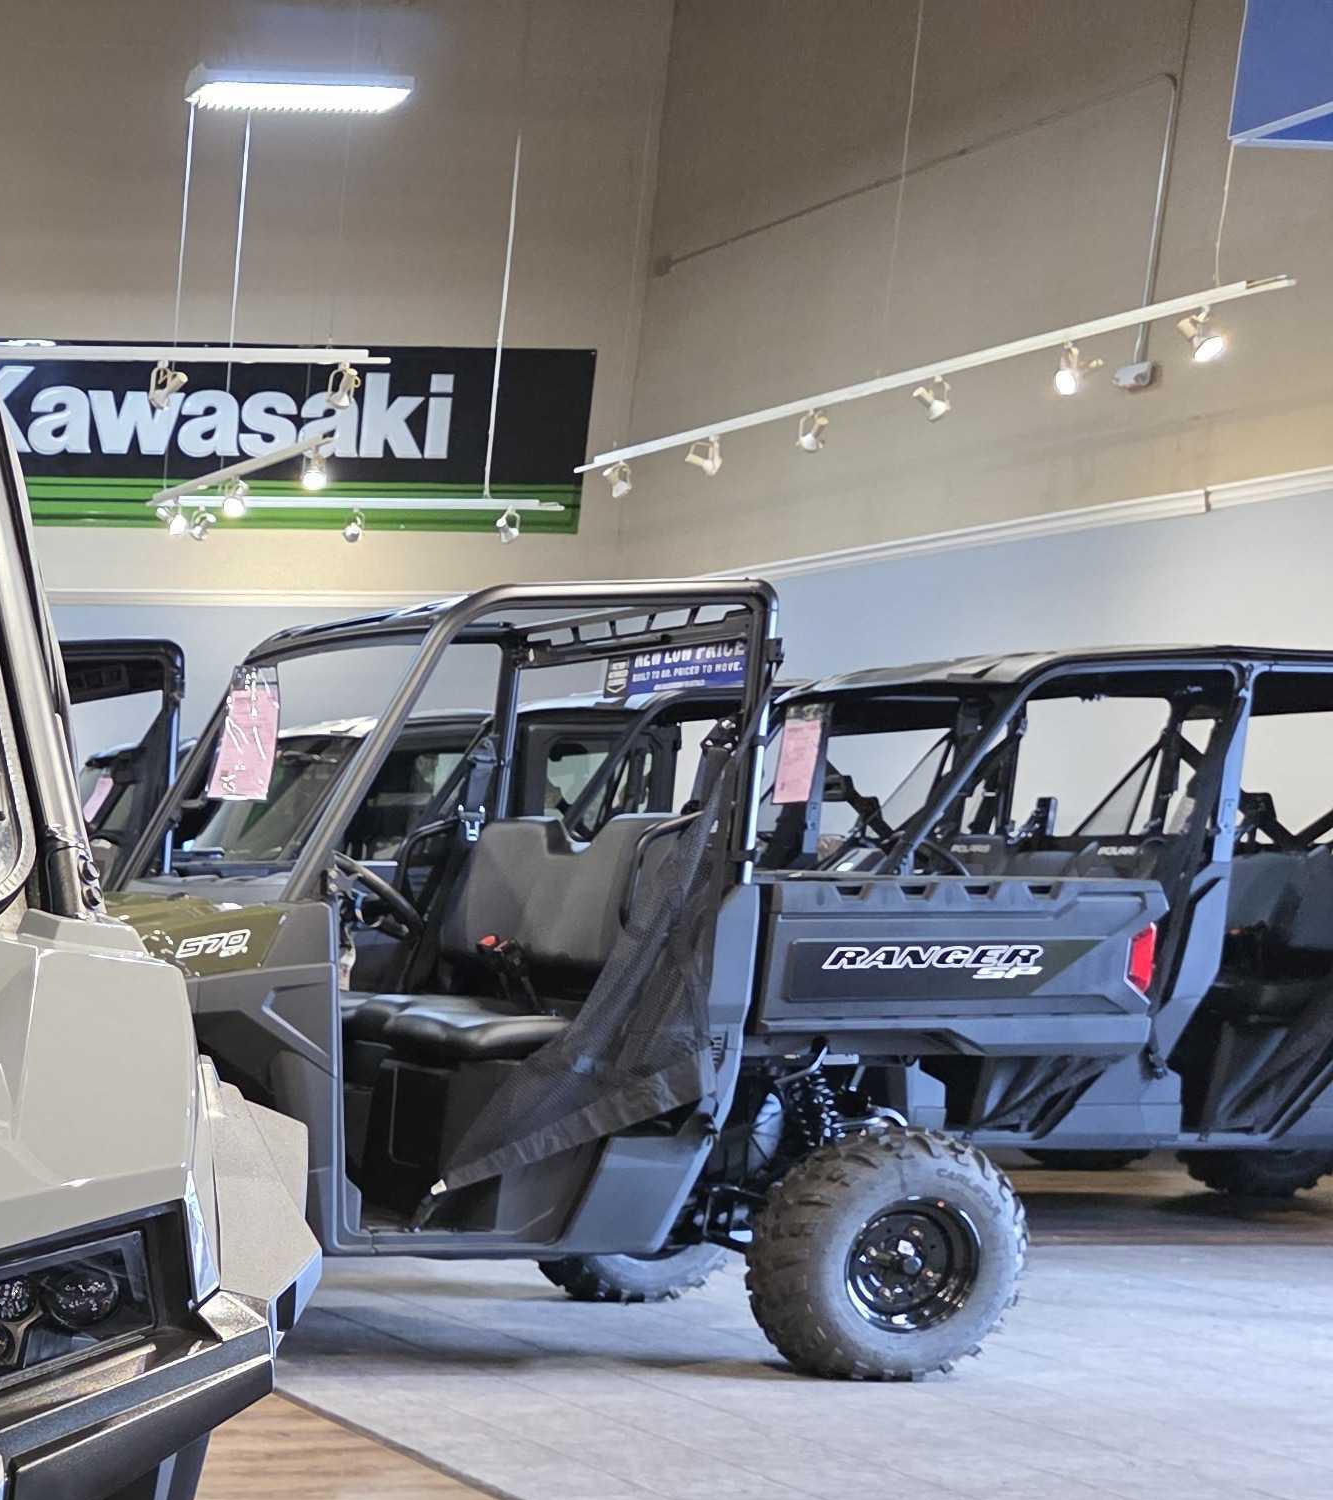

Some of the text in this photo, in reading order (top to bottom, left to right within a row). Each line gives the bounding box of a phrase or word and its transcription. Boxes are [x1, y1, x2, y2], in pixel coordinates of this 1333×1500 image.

[702, 663, 712, 674] TO
[175, 929, 251, 958] 570
[822, 945, 1044, 969] RANGER
[972, 966, 1044, 979] SP
